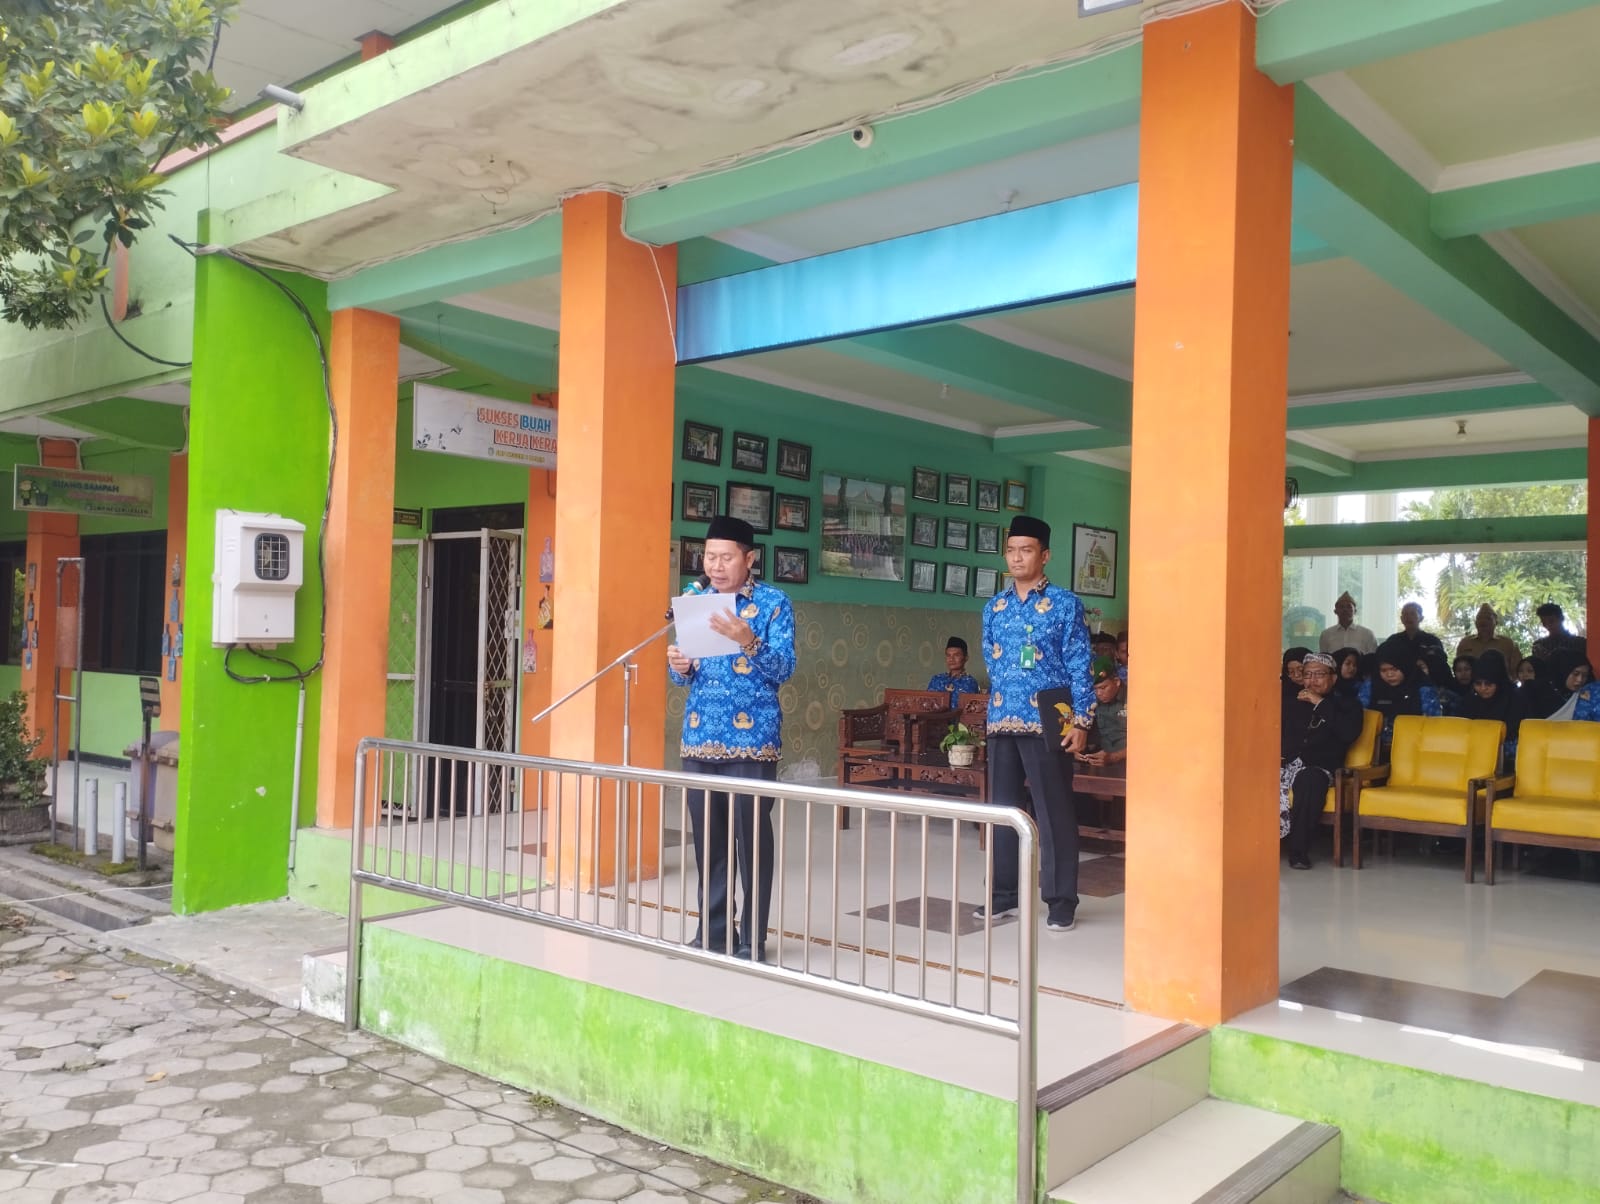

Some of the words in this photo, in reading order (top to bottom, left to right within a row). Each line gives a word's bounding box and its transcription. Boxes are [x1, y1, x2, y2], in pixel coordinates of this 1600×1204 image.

[477, 408, 519, 428] SUKSES
[520, 415, 552, 433] BUAH
[494, 429, 529, 449] KERJA
[530, 435, 557, 454] KERA
[83, 481, 120, 493] SAMPAH
